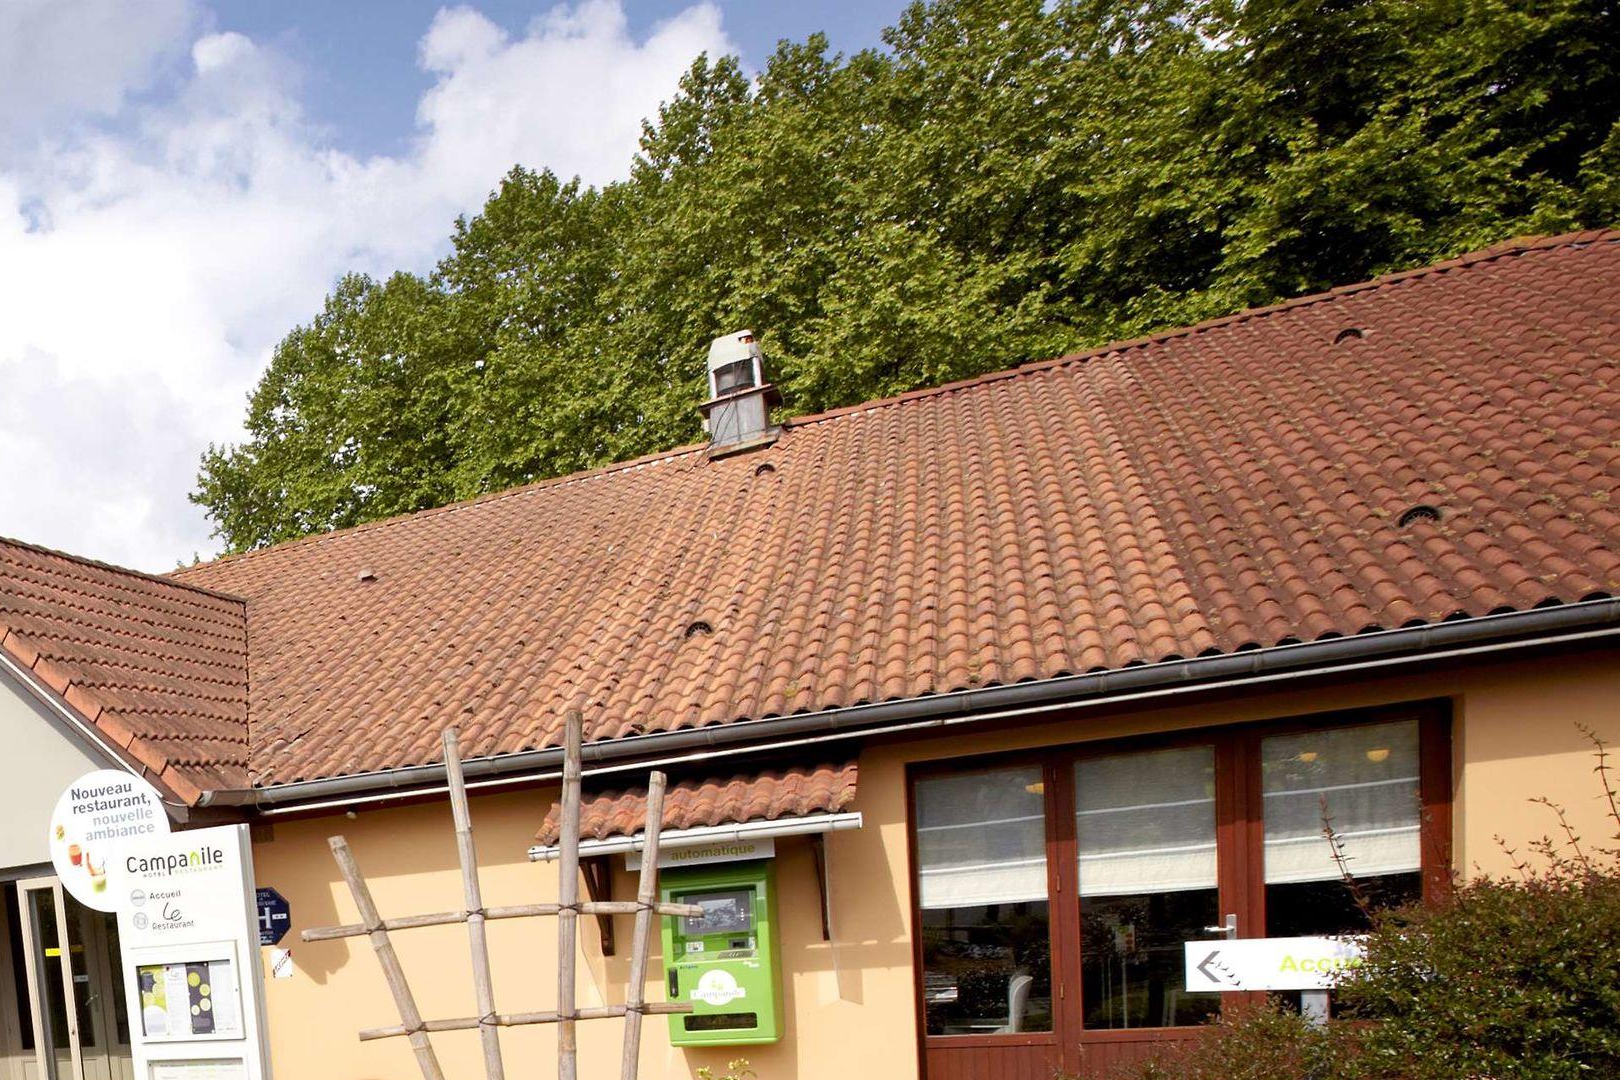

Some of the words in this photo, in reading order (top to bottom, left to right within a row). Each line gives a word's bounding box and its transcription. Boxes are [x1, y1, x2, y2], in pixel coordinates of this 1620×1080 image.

[71, 783, 132, 801] Nouveau
[73, 793, 151, 815] restaurant,
[93, 808, 153, 826] nouvelle
[86, 823, 155, 842] ambiance
[126, 846, 223, 876] Campanile
[671, 843, 756, 861] automatique
[149, 890, 181, 900] Accueil
[162, 901, 183, 922] Le
[152, 919, 194, 931] Restaurant
